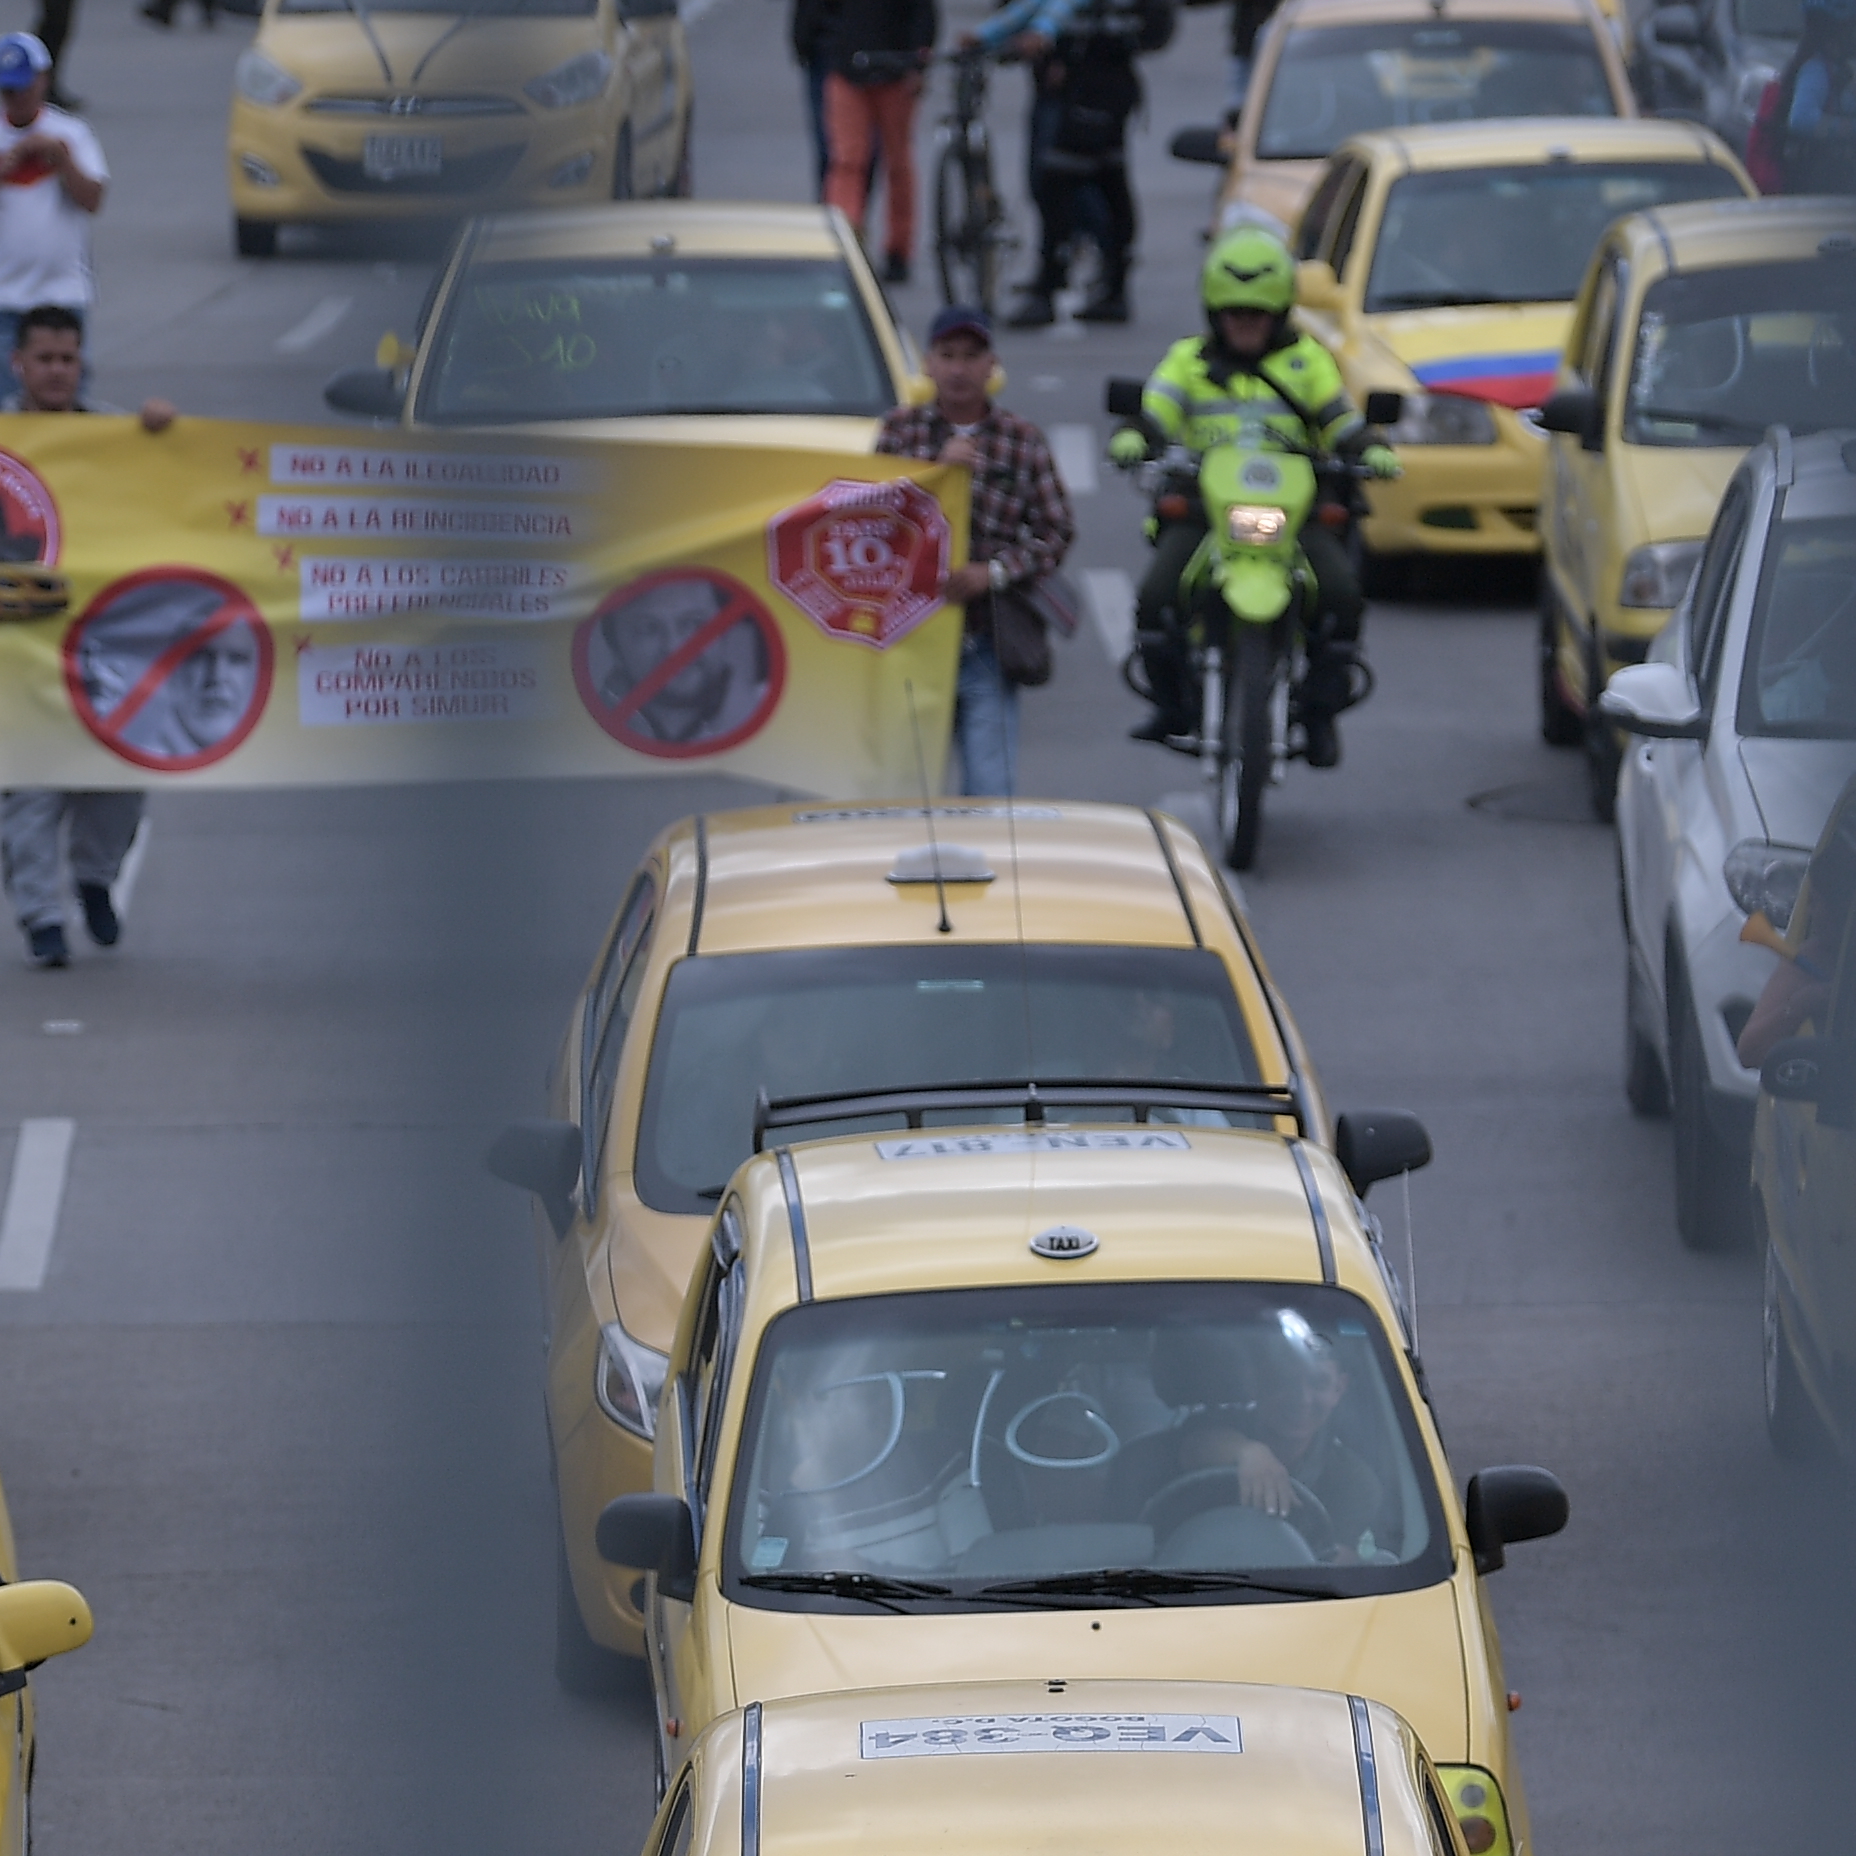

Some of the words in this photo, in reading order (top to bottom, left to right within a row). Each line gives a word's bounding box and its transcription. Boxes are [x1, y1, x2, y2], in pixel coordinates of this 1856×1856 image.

[290, 453, 326, 476] NO
[336, 455, 353, 477] A
[362, 456, 395, 479] LA
[277, 506, 313, 528] NO
[322, 507, 340, 528] A
[349, 508, 382, 530] LA
[824, 536, 895, 575] 10
[311, 563, 347, 586] NO
[356, 563, 373, 585] A
[354, 648, 392, 671] NO
[404, 647, 423, 667] A
[345, 697, 401, 719] POR
[1048, 1235, 1081, 1251] TAXI
[868, 1725, 1233, 1750] VEQ-384
